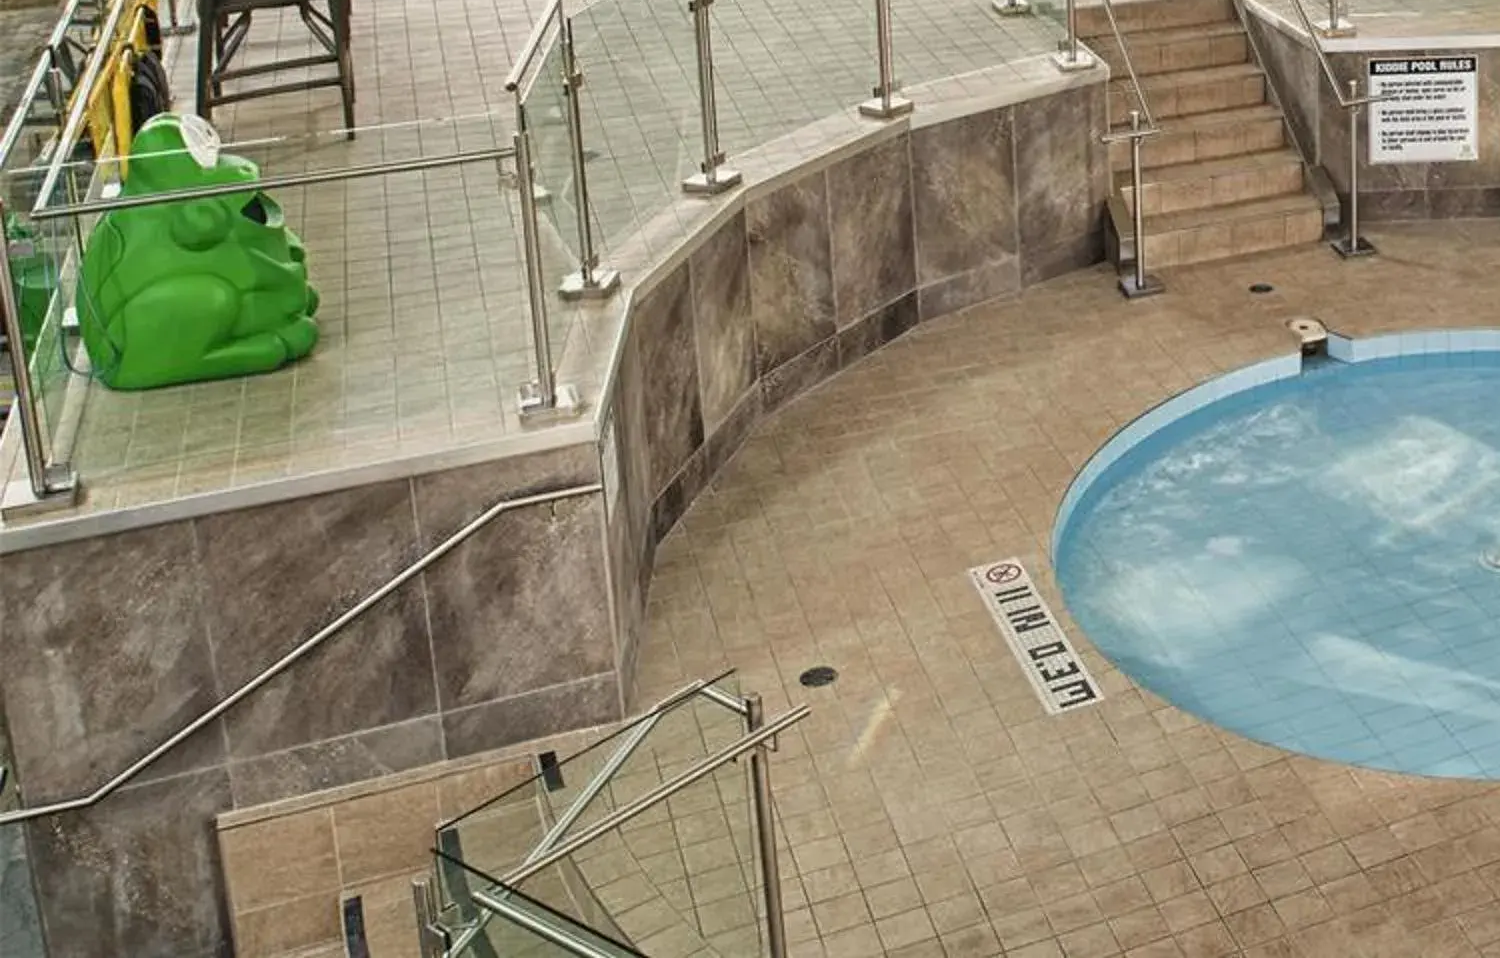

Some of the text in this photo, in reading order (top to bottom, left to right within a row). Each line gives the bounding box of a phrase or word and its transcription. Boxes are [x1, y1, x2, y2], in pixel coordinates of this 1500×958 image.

[1375, 59, 1471, 73] KIDDIE POOL RULES
